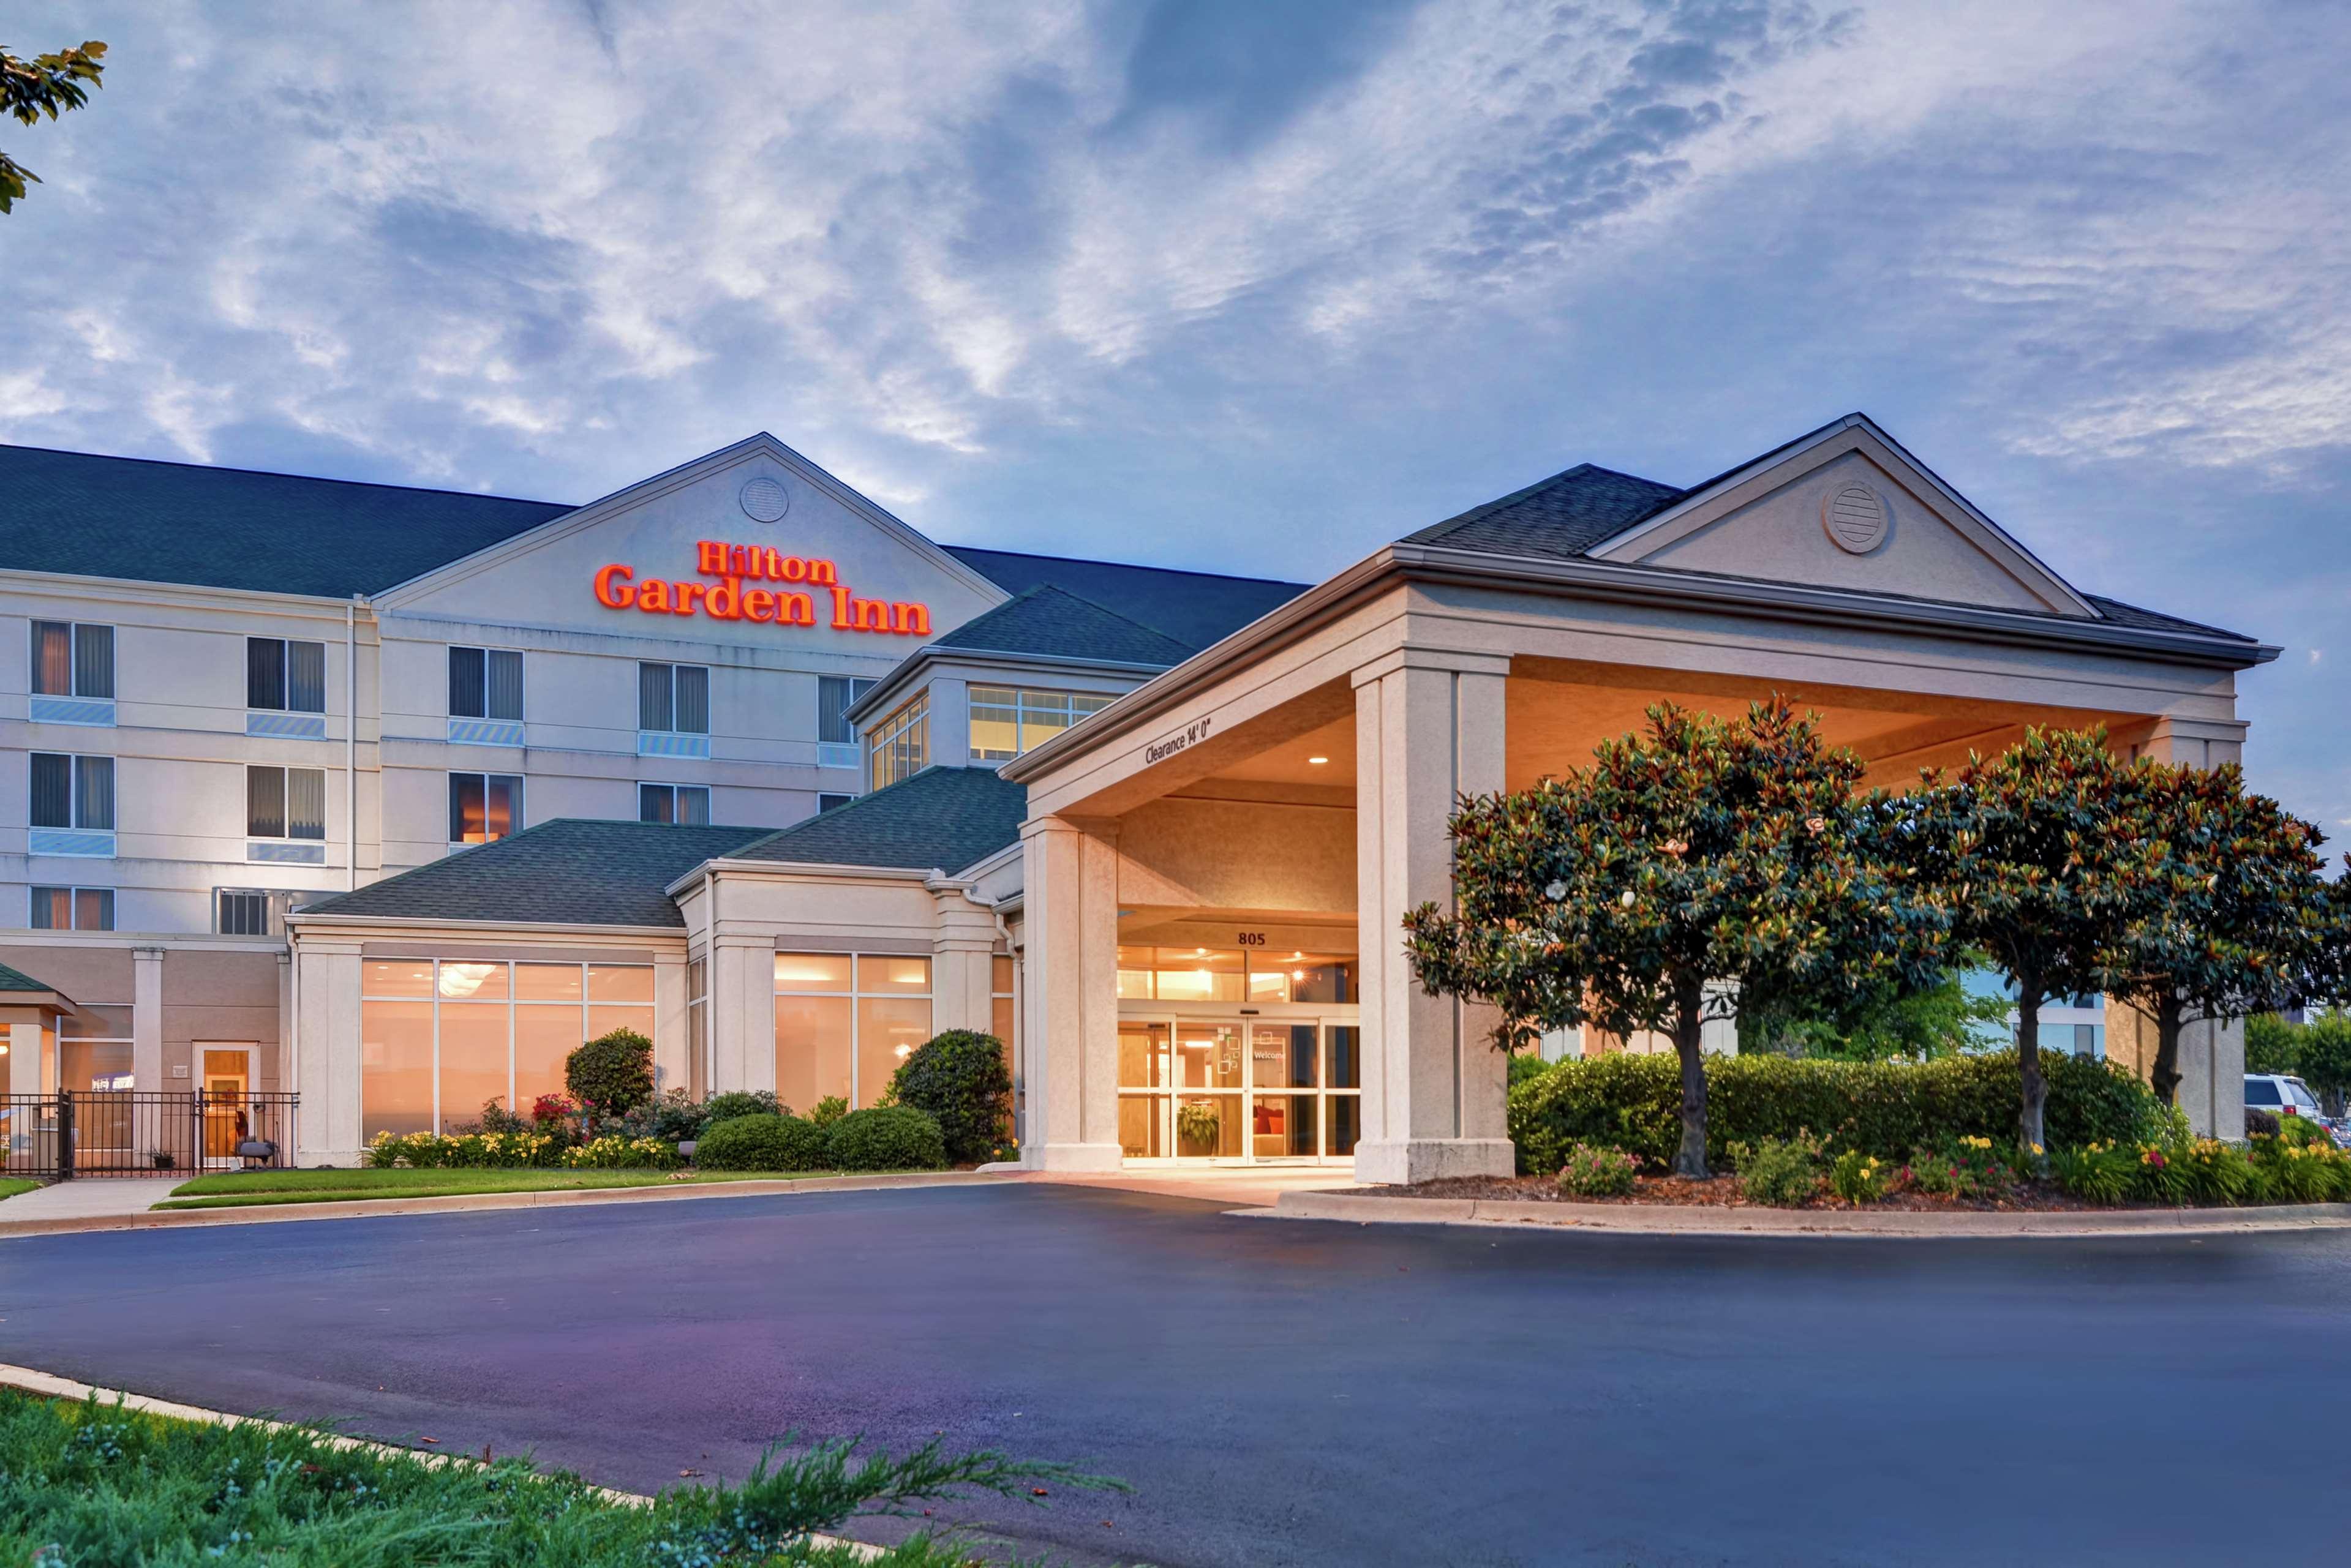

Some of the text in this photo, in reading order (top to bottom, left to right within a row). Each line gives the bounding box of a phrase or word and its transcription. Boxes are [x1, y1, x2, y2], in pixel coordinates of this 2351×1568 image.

[697, 541, 837, 586] Hilton
[594, 565, 932, 636] Garden Inn
[1146, 735, 1186, 764] Clearance
[1238, 932, 1266, 946] 805
